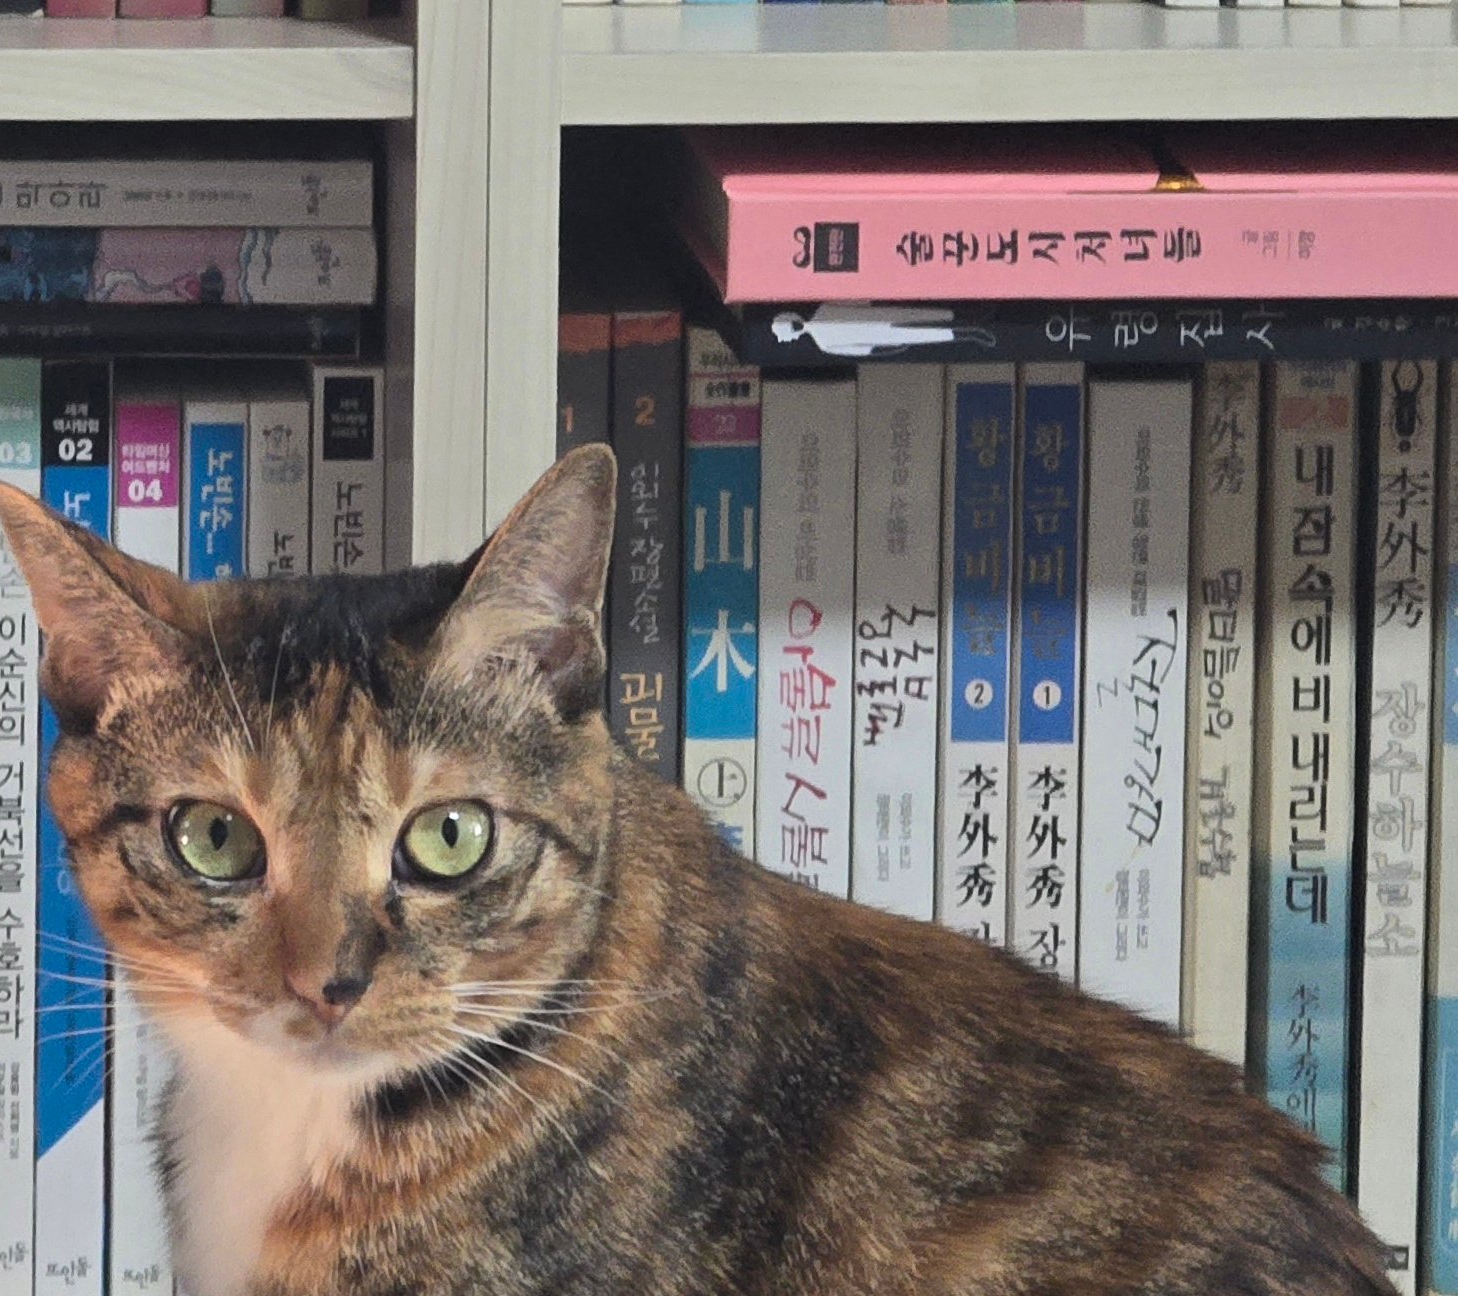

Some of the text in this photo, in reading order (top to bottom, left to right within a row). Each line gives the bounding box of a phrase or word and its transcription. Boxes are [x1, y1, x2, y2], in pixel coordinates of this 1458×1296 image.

[895, 229, 1204, 263] 술꾼도시처녀들
[58, 439, 93, 461] 02
[128, 479, 164, 502] 04
[1286, 445, 1334, 924] 내 속에 내리는데
[956, 764, 998, 906] 李外秀
[1024, 764, 1066, 909] 李外秀
[1367, 683, 1425, 957] 장수하늘소
